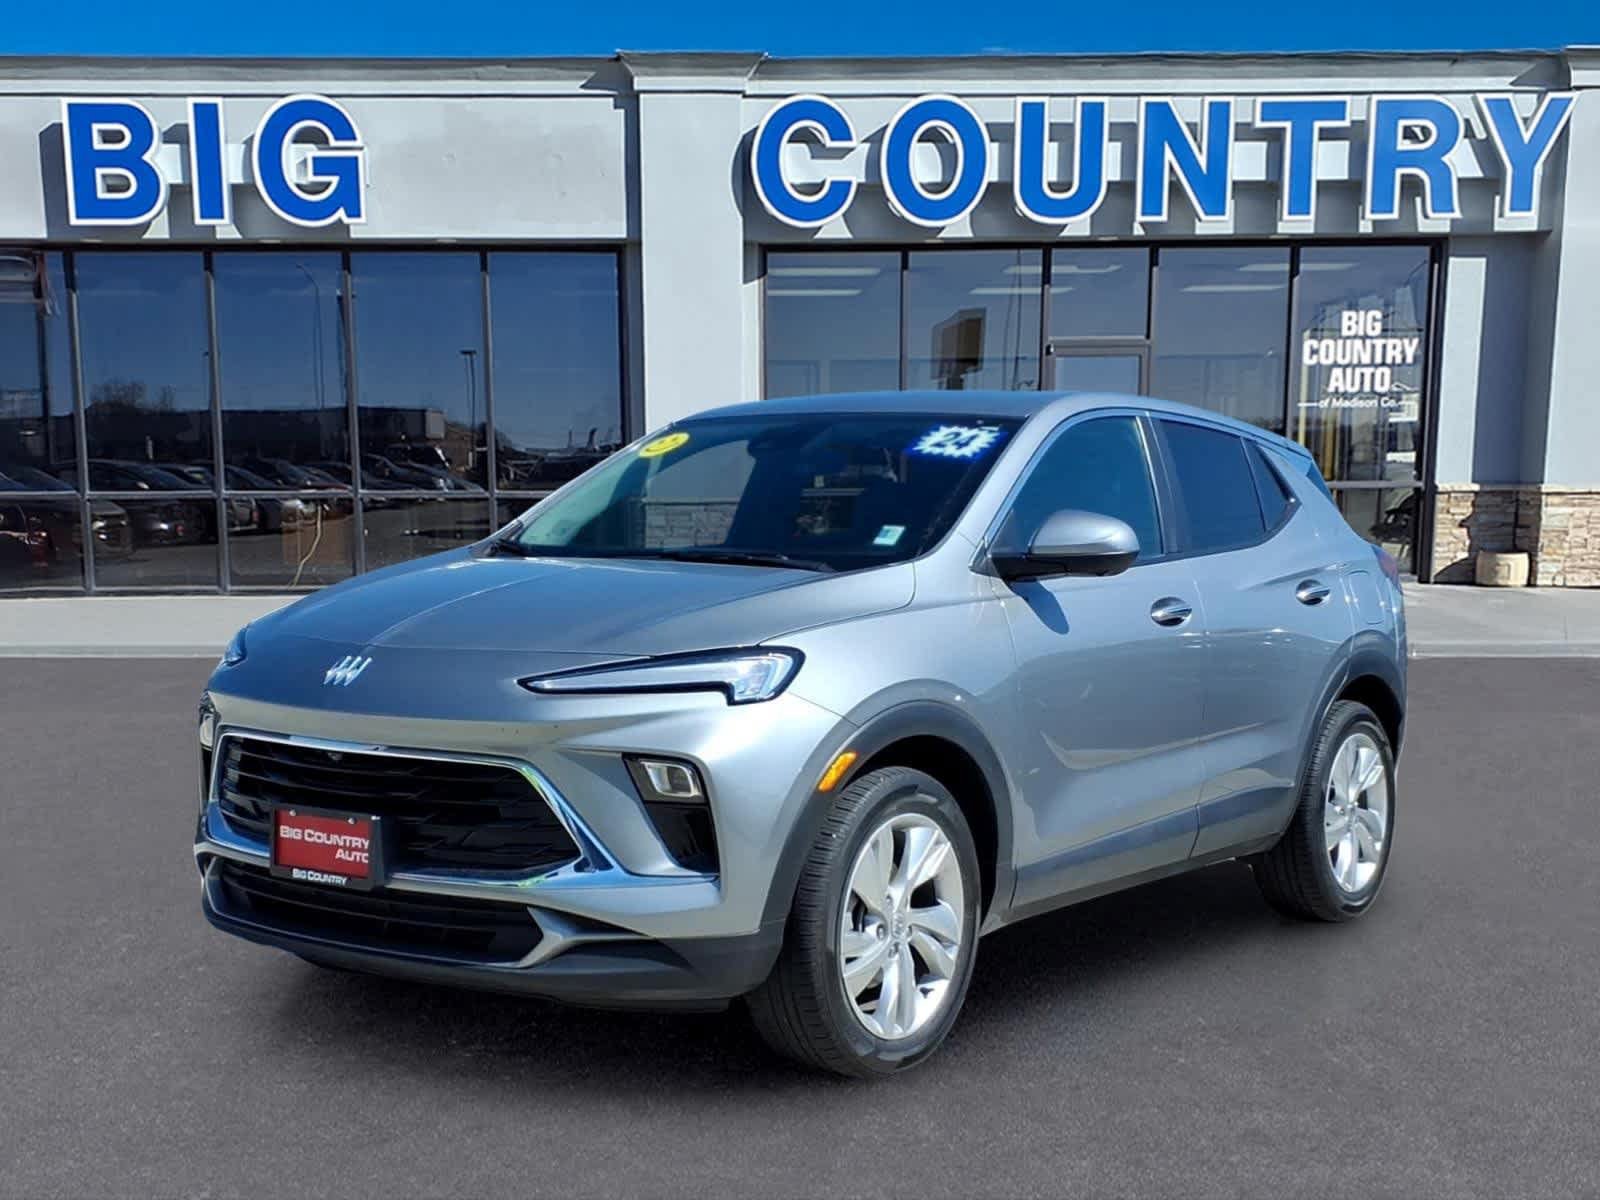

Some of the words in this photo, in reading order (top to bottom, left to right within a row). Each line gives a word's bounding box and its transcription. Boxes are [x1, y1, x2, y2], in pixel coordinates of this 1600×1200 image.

[61, 94, 367, 227] BIG
[750, 92, 1577, 228] COUNTRY
[1341, 310, 1382, 337] BIG
[1302, 337, 1419, 365] COUNTRY
[1327, 366, 1391, 393] AUTO
[1318, 397, 1330, 408] of
[1331, 397, 1378, 408] Madison
[279, 825, 303, 840] BIG
[304, 829, 370, 849] COUNTRY
[335, 848, 369, 864] AUTO
[292, 868, 307, 879] BIG
[307, 871, 348, 886] COUNTRY
